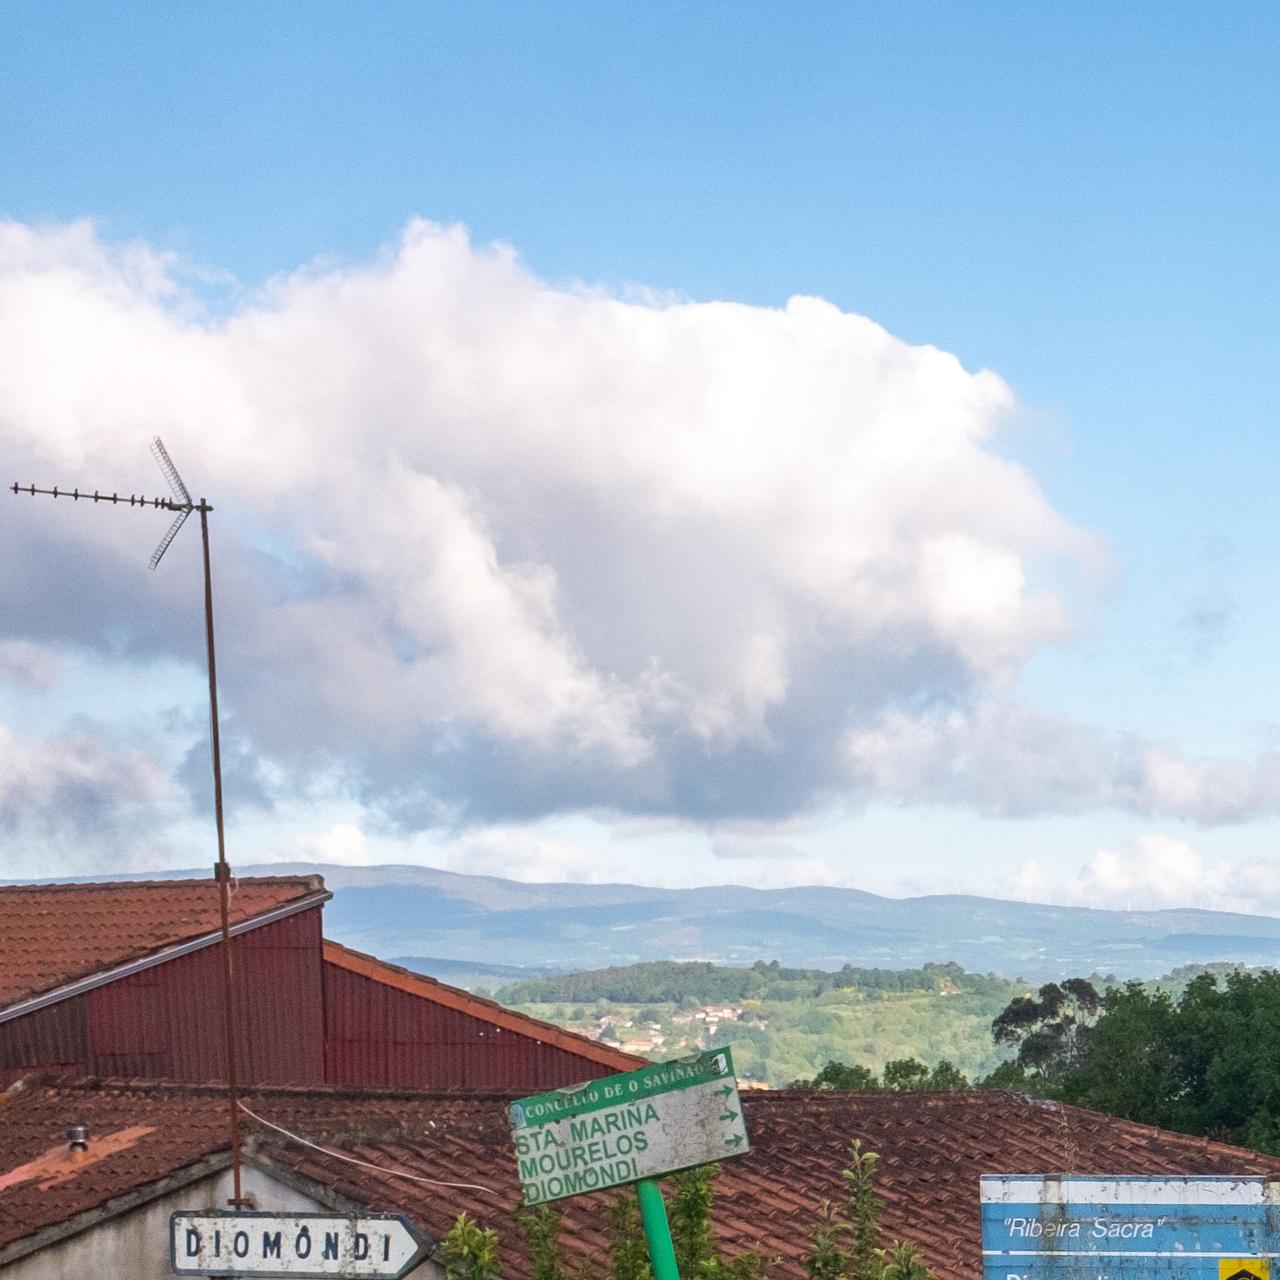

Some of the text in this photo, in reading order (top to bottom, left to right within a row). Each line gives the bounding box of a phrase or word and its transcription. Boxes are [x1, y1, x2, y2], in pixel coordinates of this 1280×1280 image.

[526, 1090, 599, 1118] CONCELLO
[604, 1084, 622, 1099] DE
[629, 1078, 639, 1093] O
[570, 1101, 661, 1143] MARIÑA
[520, 1130, 649, 1180] MOURELOS
